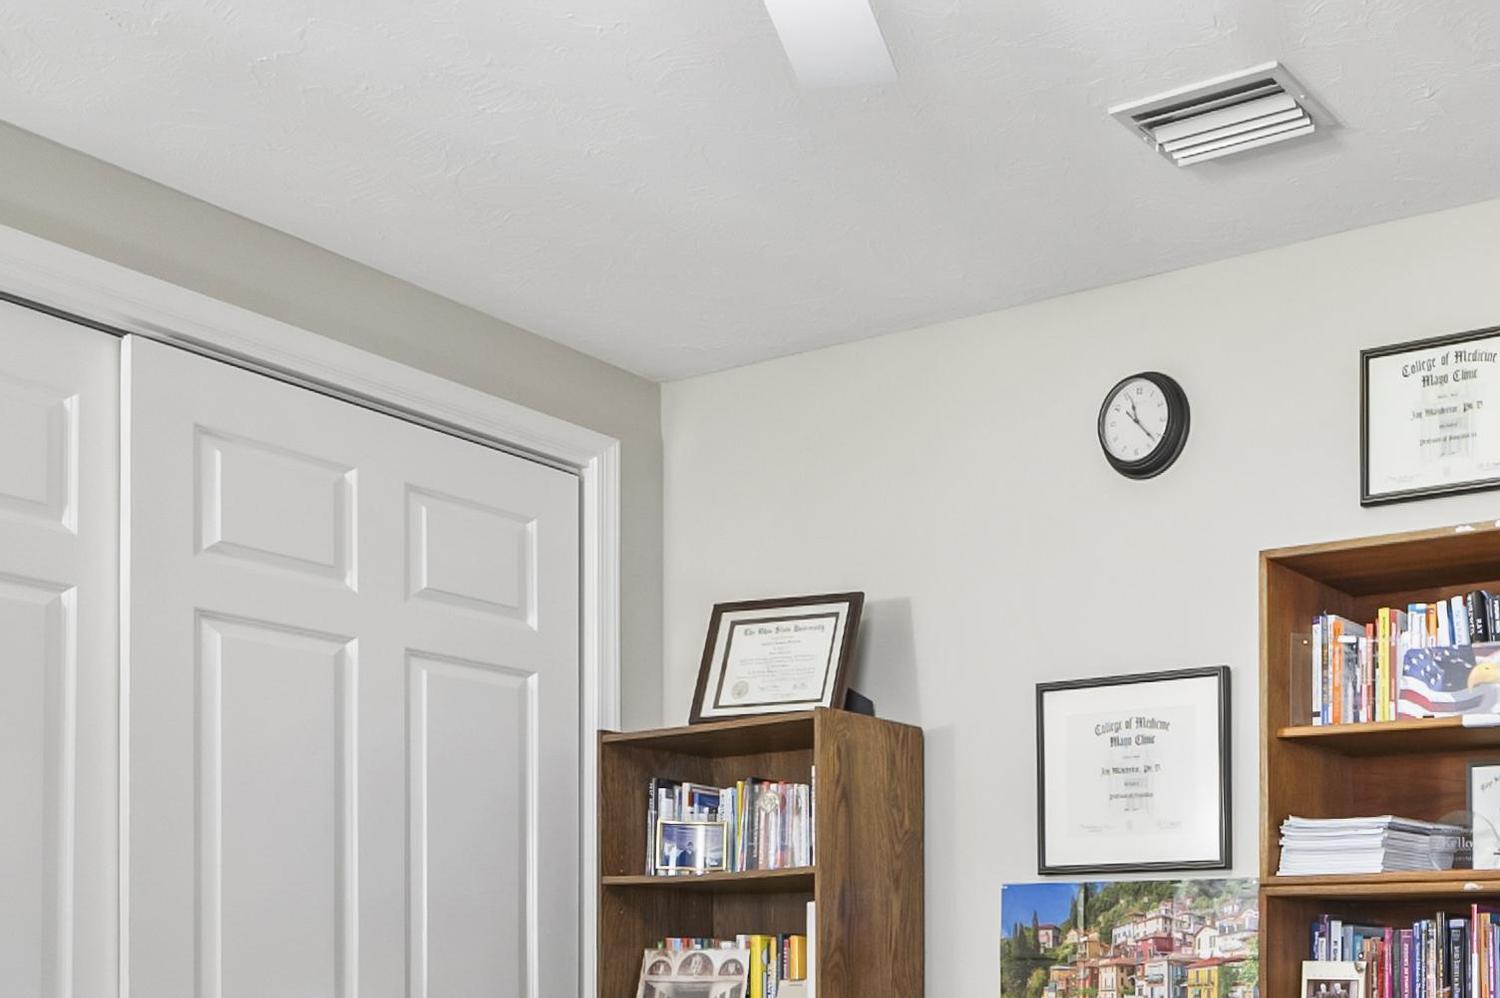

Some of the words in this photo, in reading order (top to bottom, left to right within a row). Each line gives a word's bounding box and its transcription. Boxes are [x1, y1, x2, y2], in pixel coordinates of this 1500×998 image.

[1402, 358, 1436, 378] College
[1441, 352, 1449, 366] of
[1454, 350, 1498, 363] Medicine
